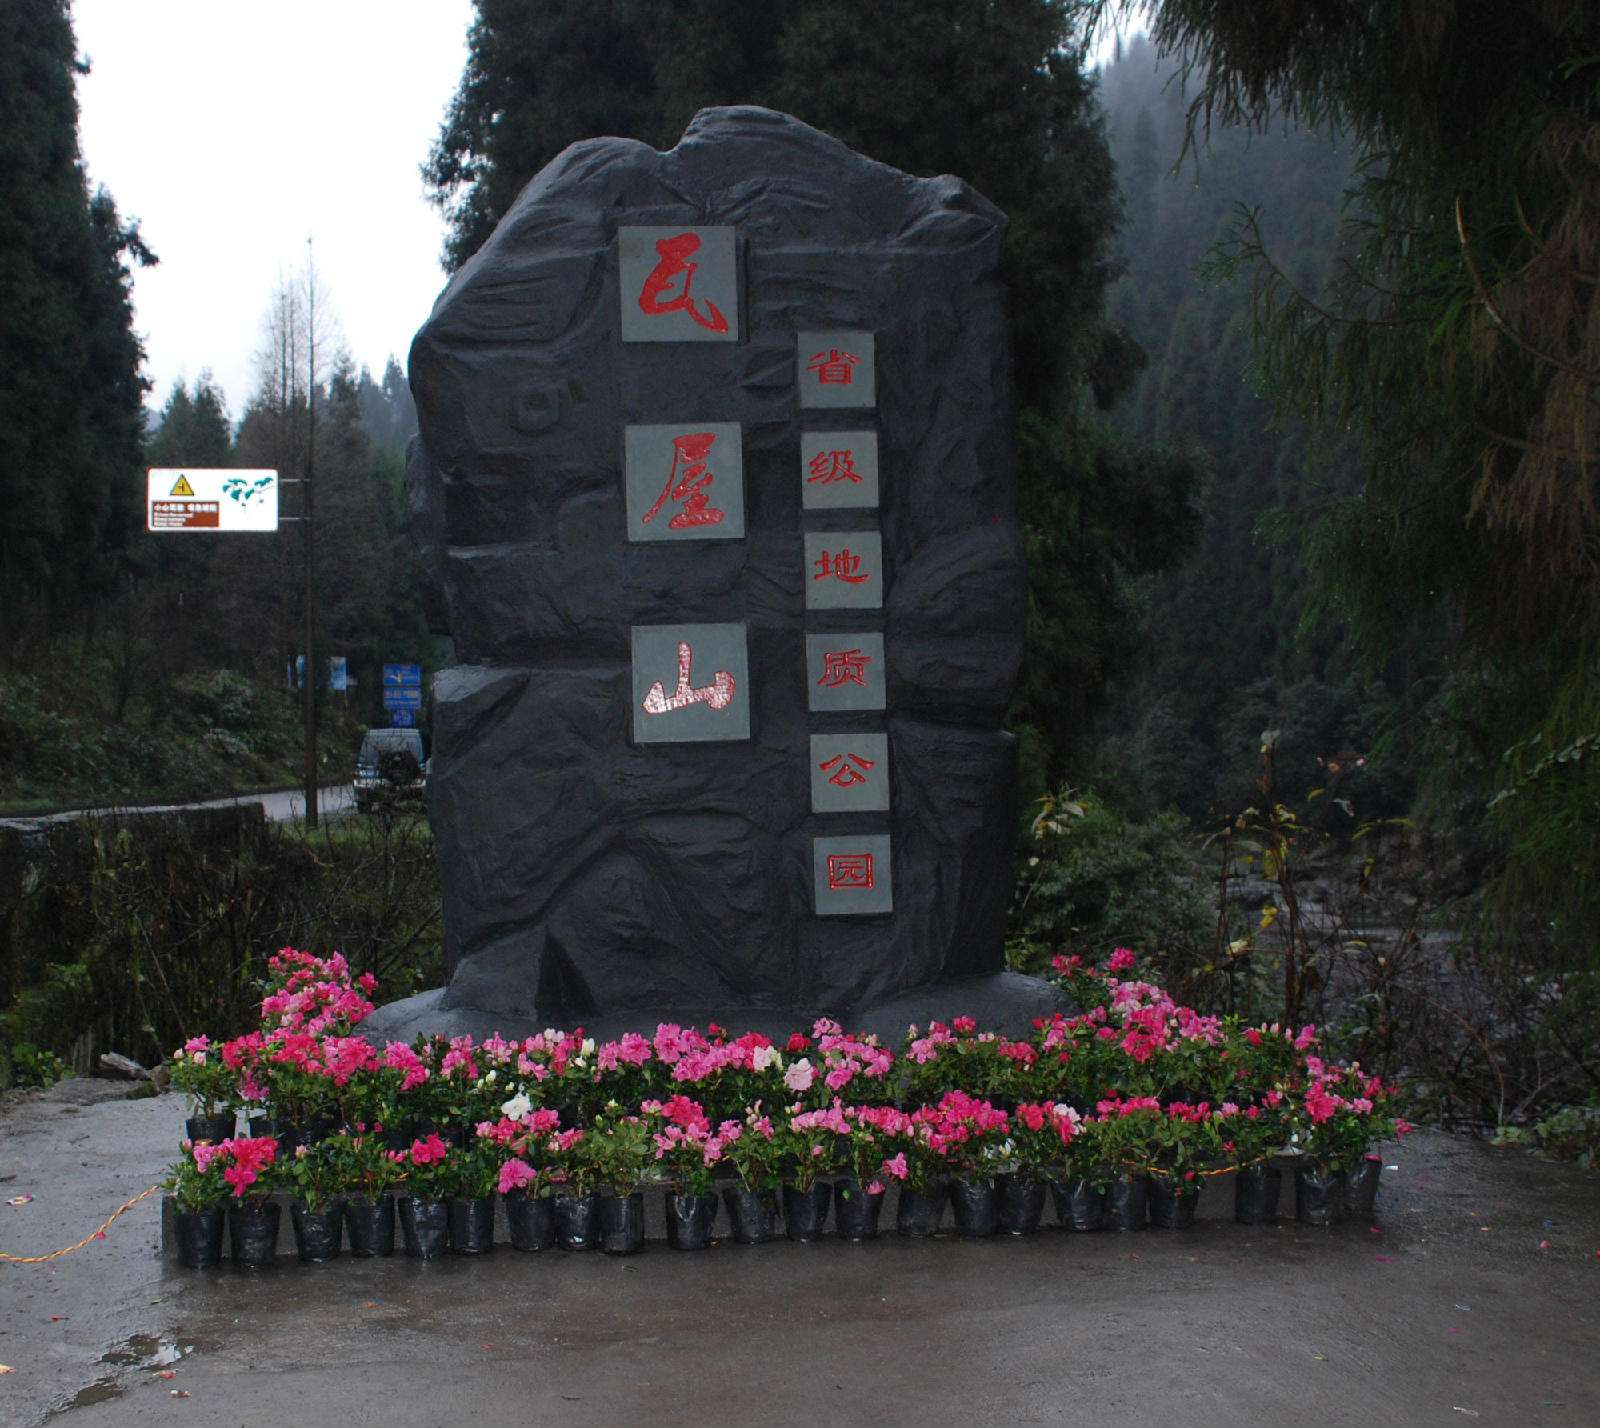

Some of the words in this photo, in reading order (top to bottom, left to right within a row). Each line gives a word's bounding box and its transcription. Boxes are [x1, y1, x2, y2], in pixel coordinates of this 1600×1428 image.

[639, 232, 737, 713] 瓦屋山
[806, 349, 875, 890] 省级地质公园
